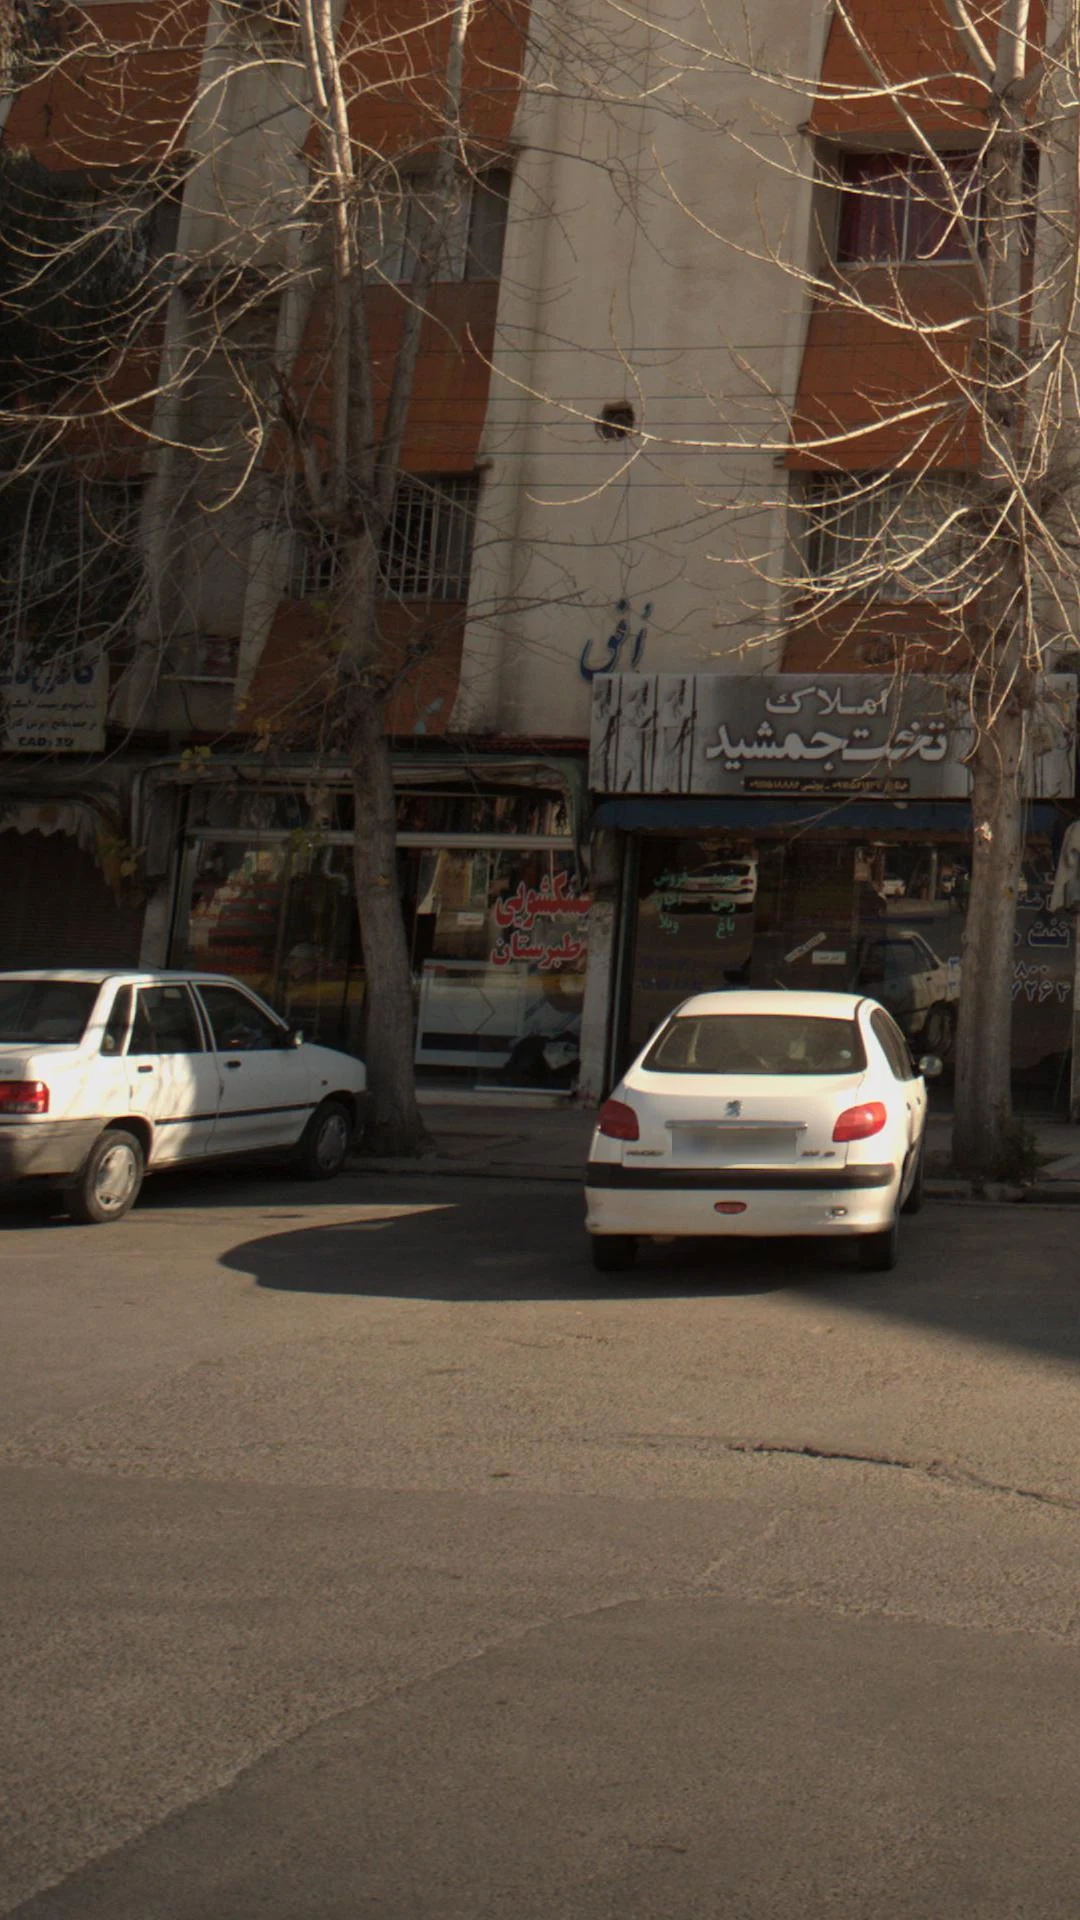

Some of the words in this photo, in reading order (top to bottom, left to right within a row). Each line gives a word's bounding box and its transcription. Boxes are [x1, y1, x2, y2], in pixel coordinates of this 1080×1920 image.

[765, 686, 889, 716] املاک
[706, 719, 846, 772] جمشید
[841, 720, 949, 762] تخت
[716, 917, 736, 939] باغ
[490, 930, 585, 970] طبرستان
